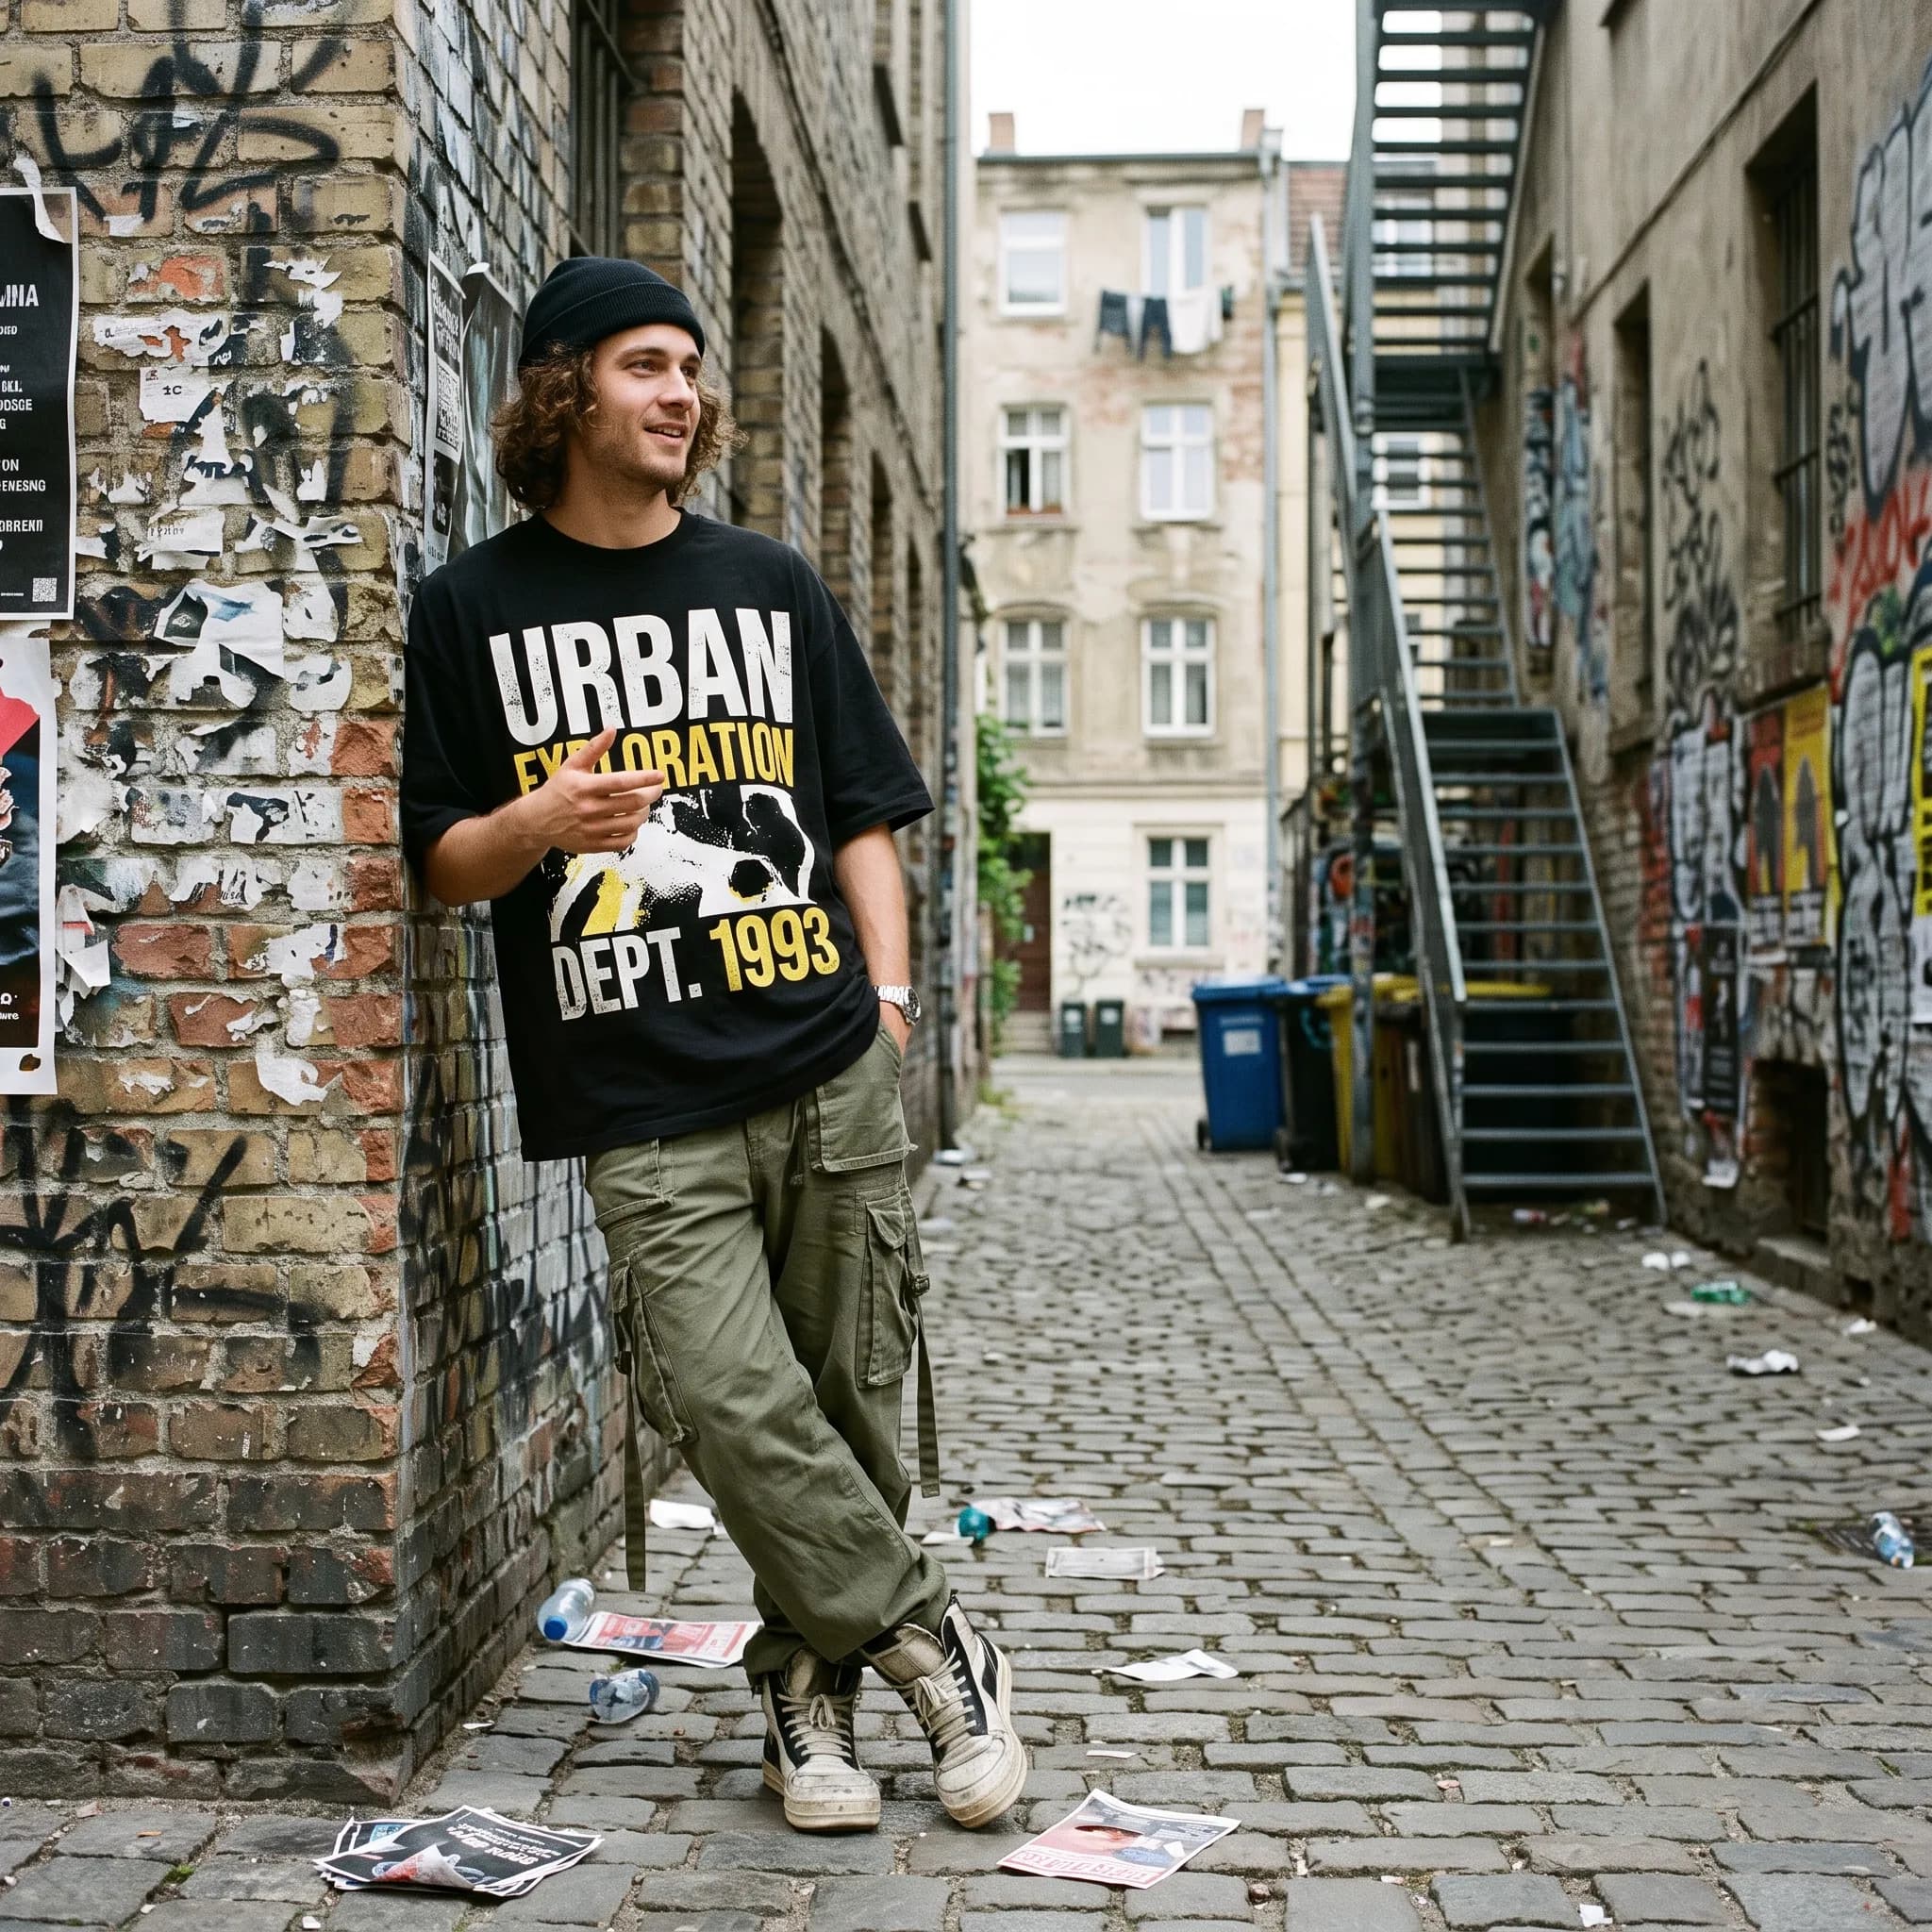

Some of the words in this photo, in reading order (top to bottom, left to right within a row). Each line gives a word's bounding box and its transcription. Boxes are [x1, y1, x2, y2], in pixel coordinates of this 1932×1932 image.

[0, 458, 19, 472] ON
[0, 479, 46, 492] ENESNG
[489, 608, 793, 745] URBAN
[513, 723, 794, 795] EXORATION
[551, 927, 703, 1022] DEPT.
[709, 908, 841, 992] 1993
